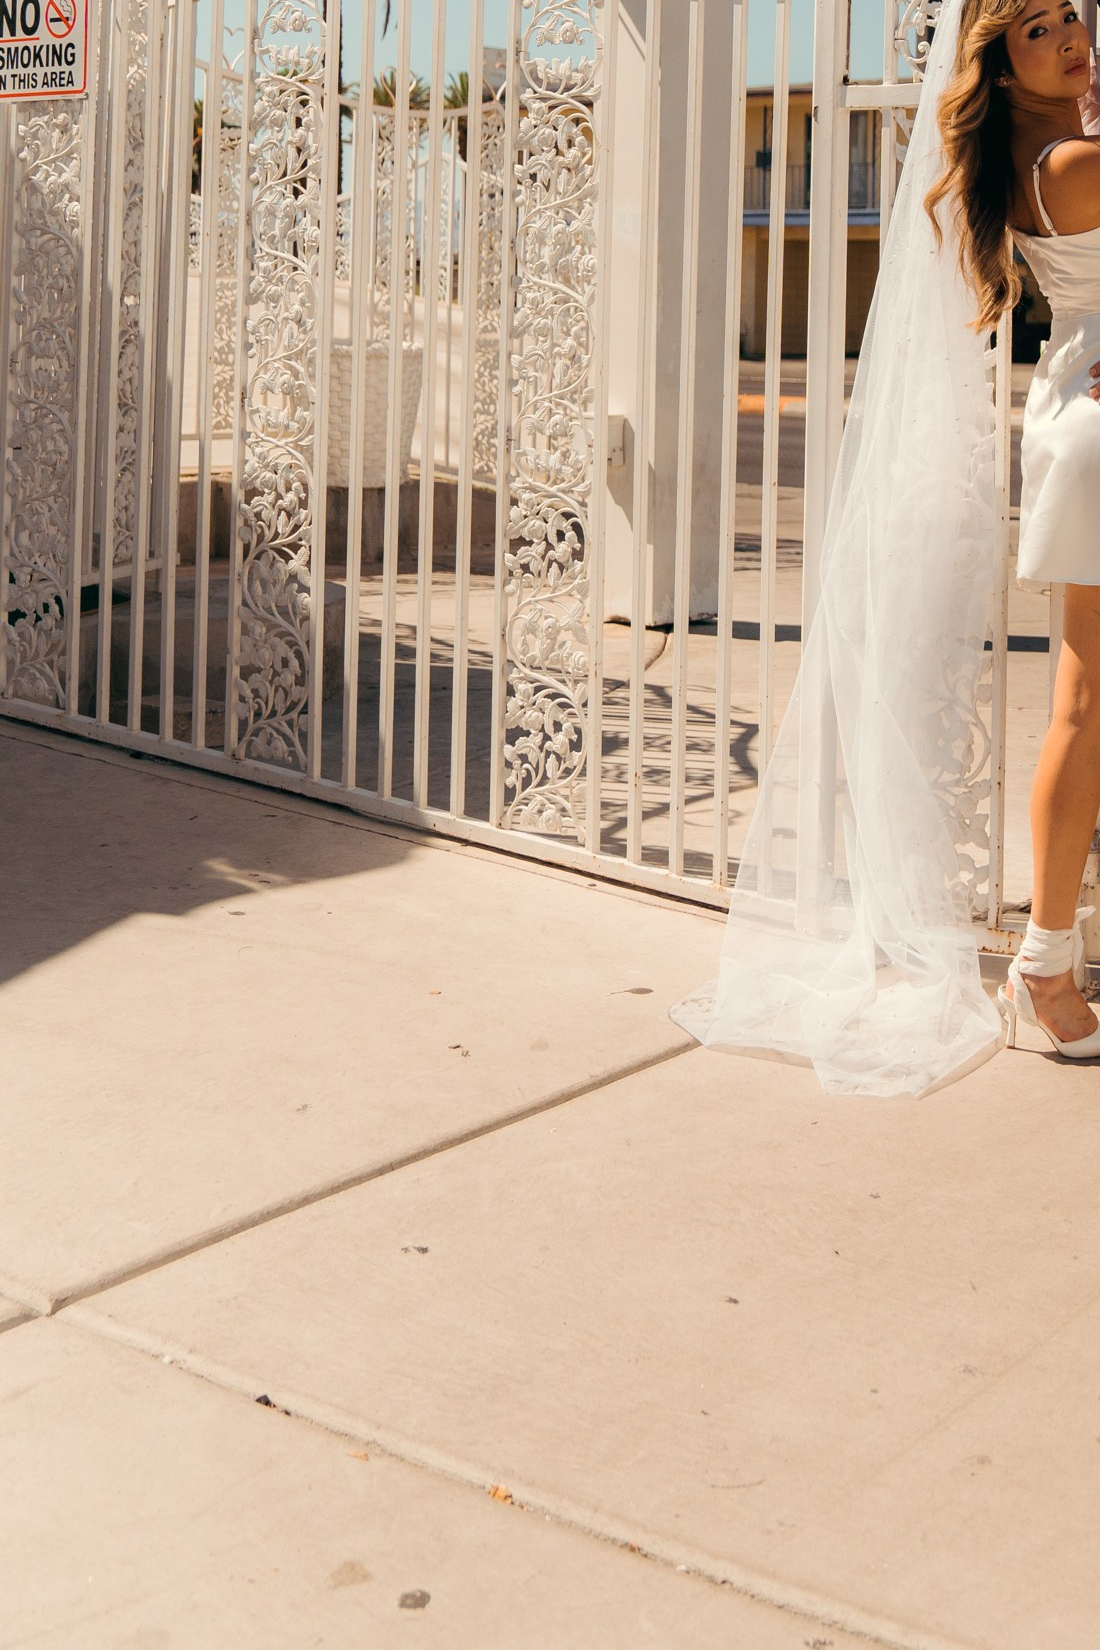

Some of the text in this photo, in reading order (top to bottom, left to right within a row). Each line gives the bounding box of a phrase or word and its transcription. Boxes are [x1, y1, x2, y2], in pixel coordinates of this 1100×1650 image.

[0, 70, 75, 91] N THIS AREA
